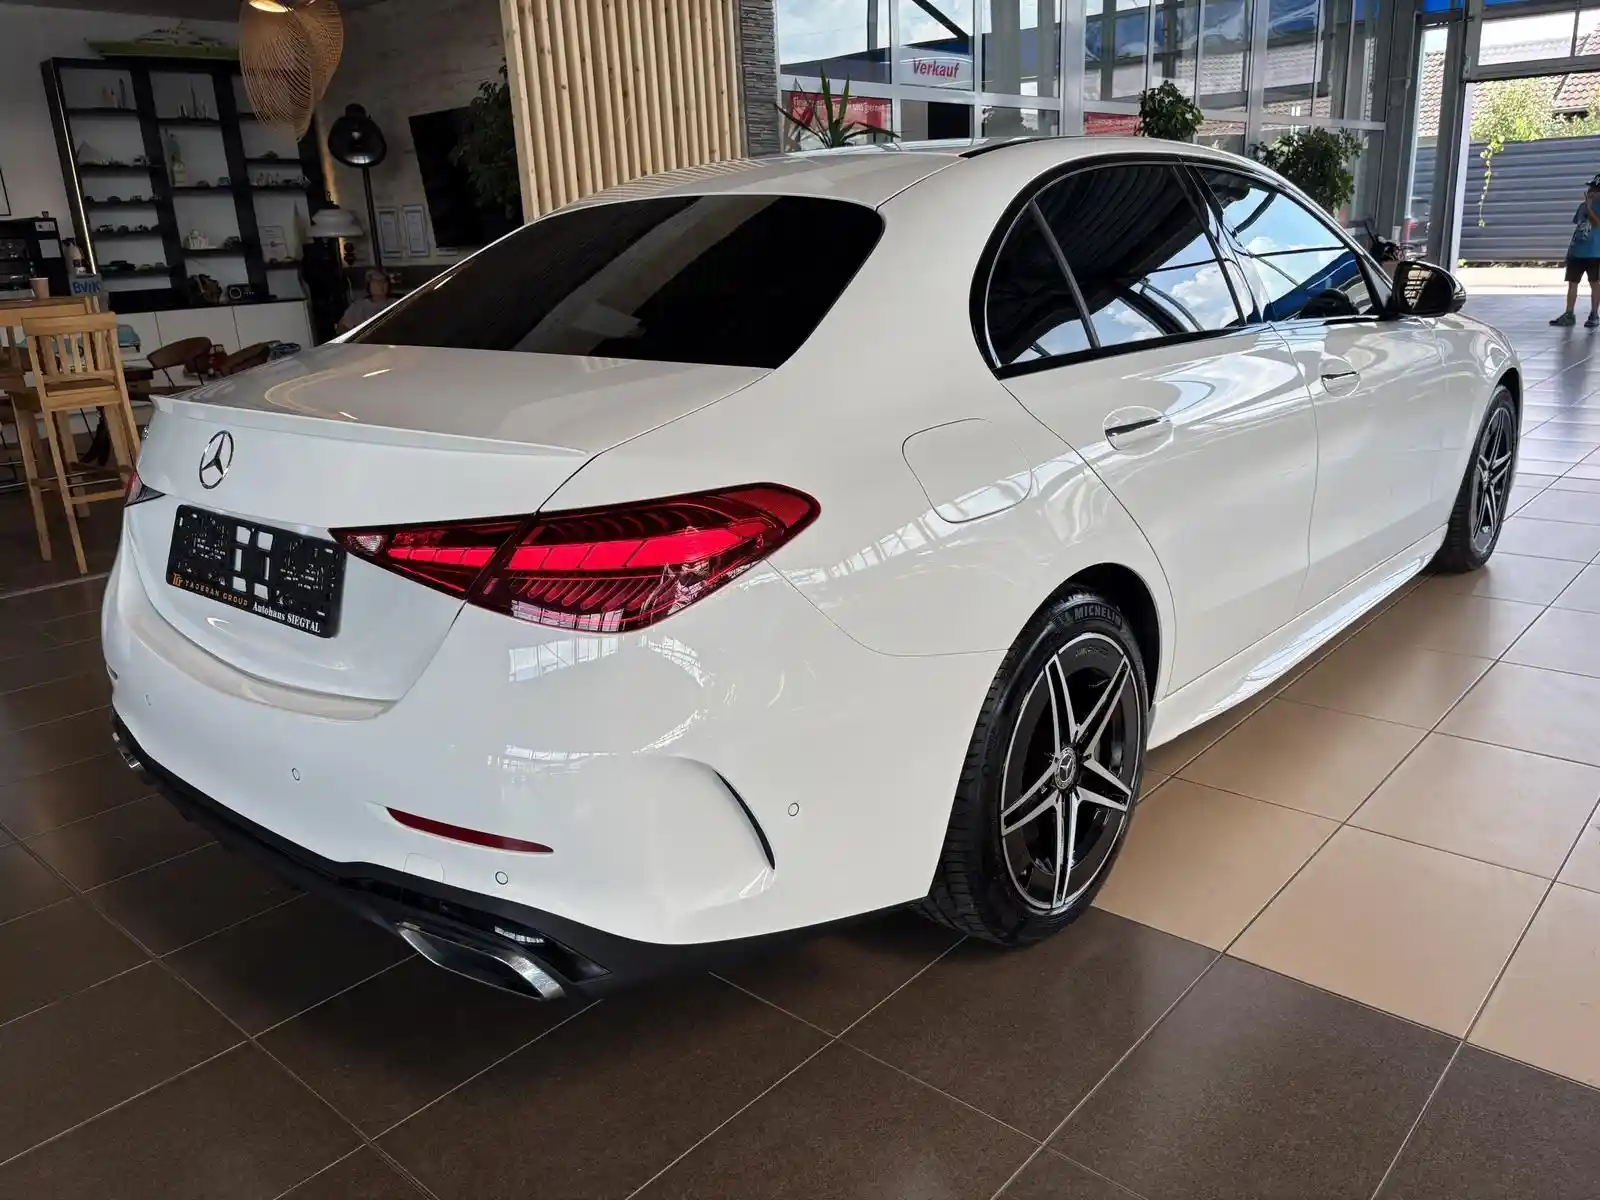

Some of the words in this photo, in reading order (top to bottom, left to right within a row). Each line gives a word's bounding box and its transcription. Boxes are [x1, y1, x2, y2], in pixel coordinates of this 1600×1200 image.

[913, 57, 960, 78] Verkauf
[252, 601, 286, 621] Autohaus
[286, 613, 321, 633] SIEGTAL
[1073, 603, 1123, 626] MICHELIN
